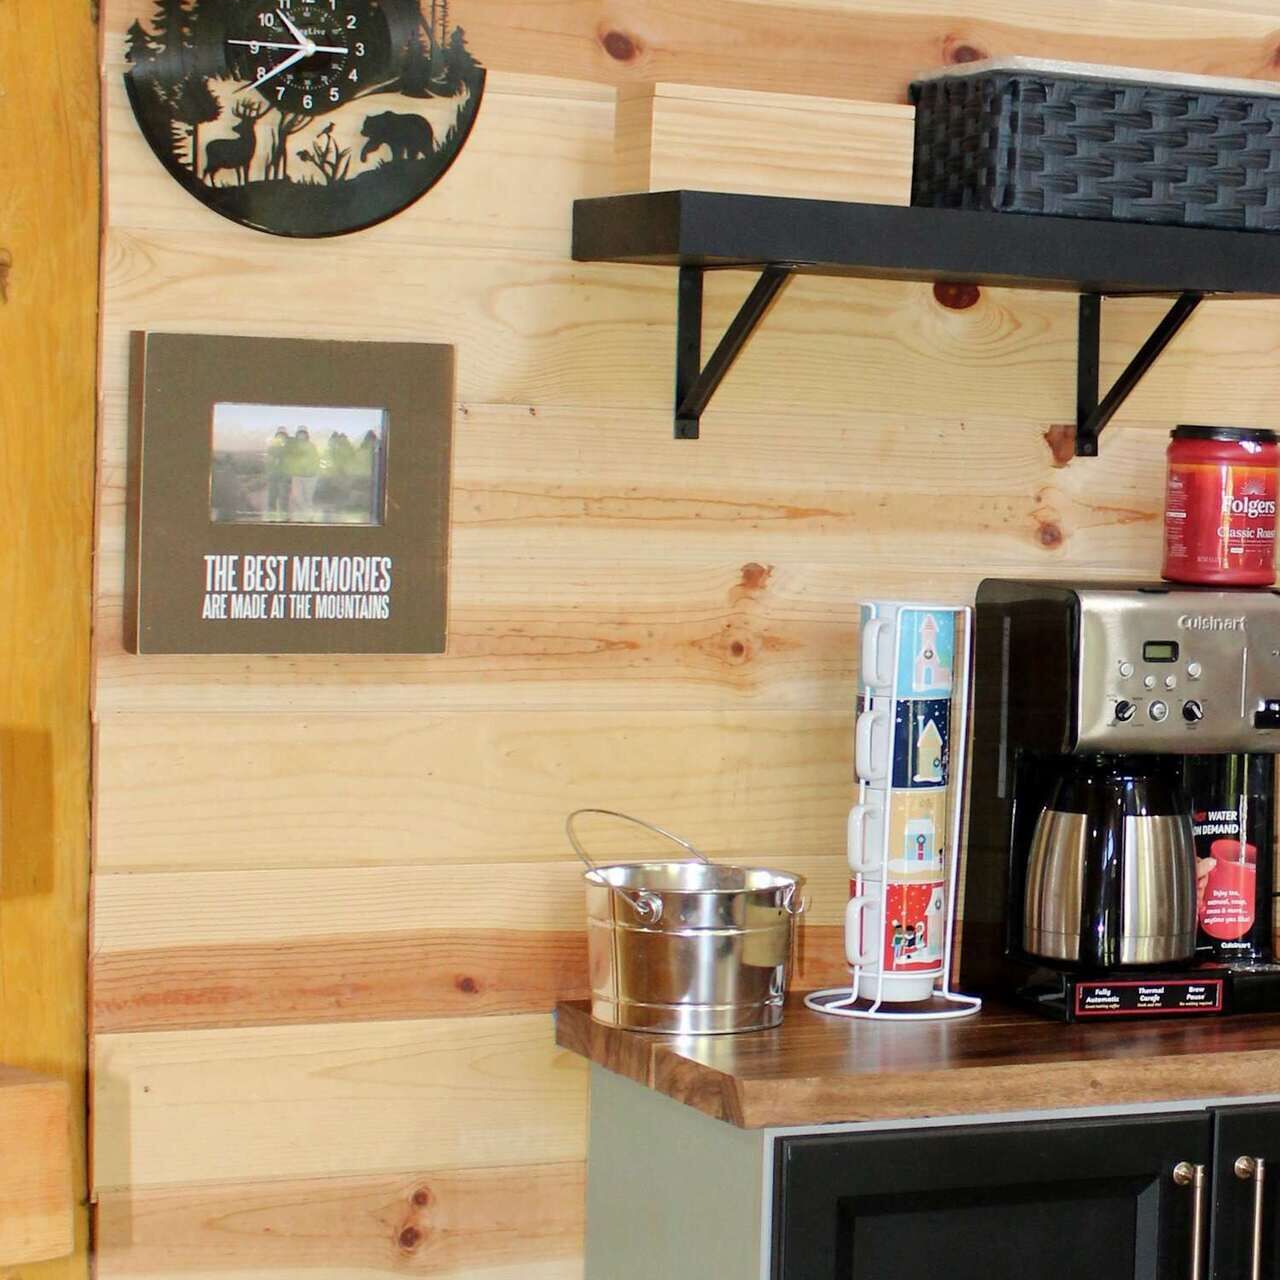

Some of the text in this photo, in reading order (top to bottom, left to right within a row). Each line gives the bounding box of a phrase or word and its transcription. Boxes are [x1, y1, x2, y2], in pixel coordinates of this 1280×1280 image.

[258, 13, 275, 27] 10
[346, 15, 357, 29] 2
[249, 39, 260, 54] 9
[355, 43, 365, 57] 3
[256, 67, 267, 80] 8
[348, 69, 359, 82] 4
[276, 87, 286, 101] 7
[329, 87, 340, 101] 5
[302, 95, 313, 109] 6
[1222, 495, 1276, 518] Folgers
[203, 555, 392, 593] THE BEST MEMORIES
[202, 593, 390, 620] ARE MADE AT THE MOUNTAINS
[1177, 614, 1248, 632] Cuisinart
[1208, 811, 1238, 821] WATER
[1203, 824, 1239, 835] DEMAND
[1138, 986, 1165, 994] Thermal
